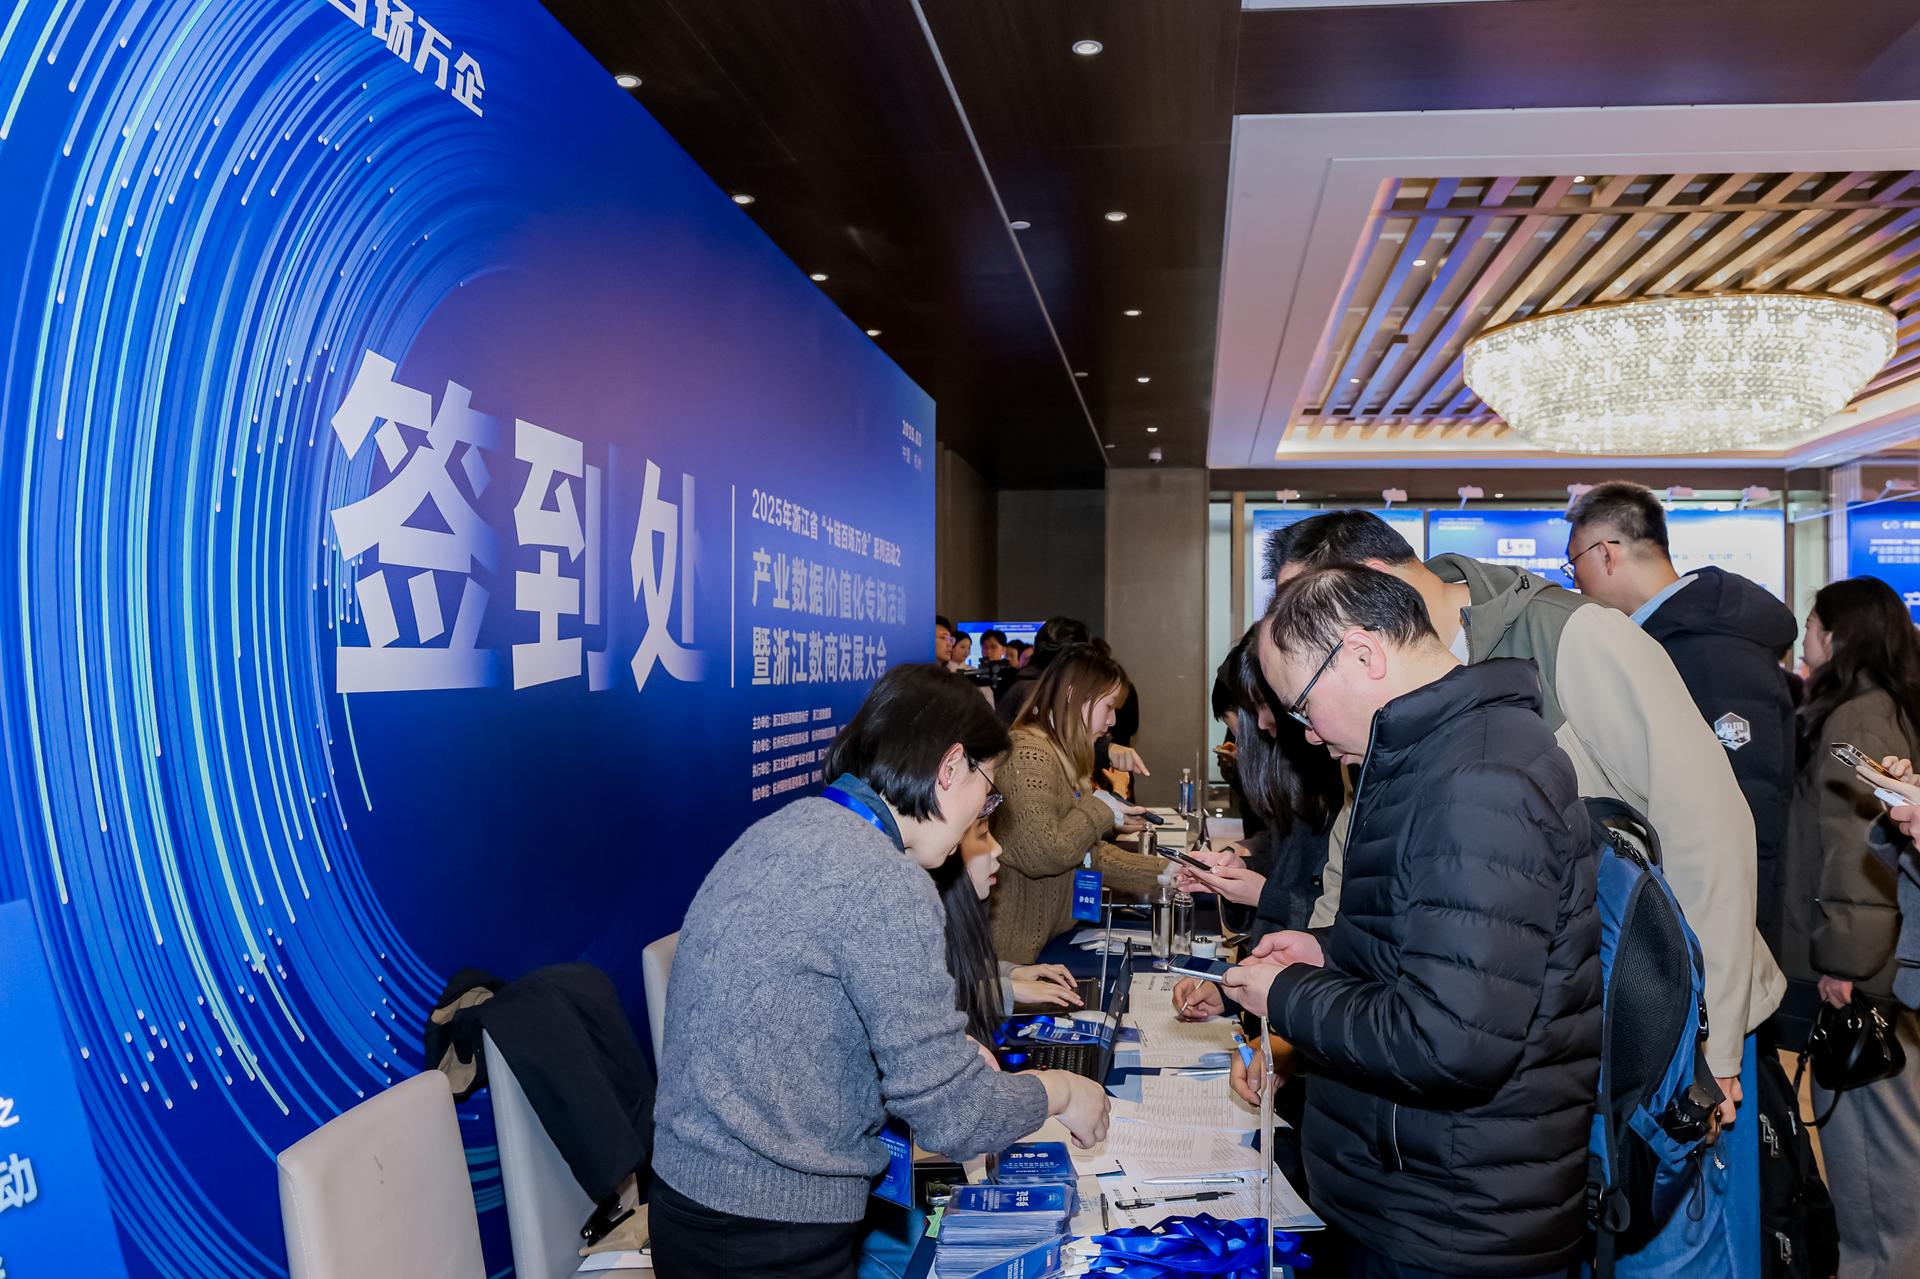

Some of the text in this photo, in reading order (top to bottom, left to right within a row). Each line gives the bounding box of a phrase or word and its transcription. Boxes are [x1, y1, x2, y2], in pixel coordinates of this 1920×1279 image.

[331, 349, 709, 693] 签到处
[752, 547, 907, 625] 产业数据价值化专场活动
[752, 626, 887, 686] 暨浙江数商发展大会
